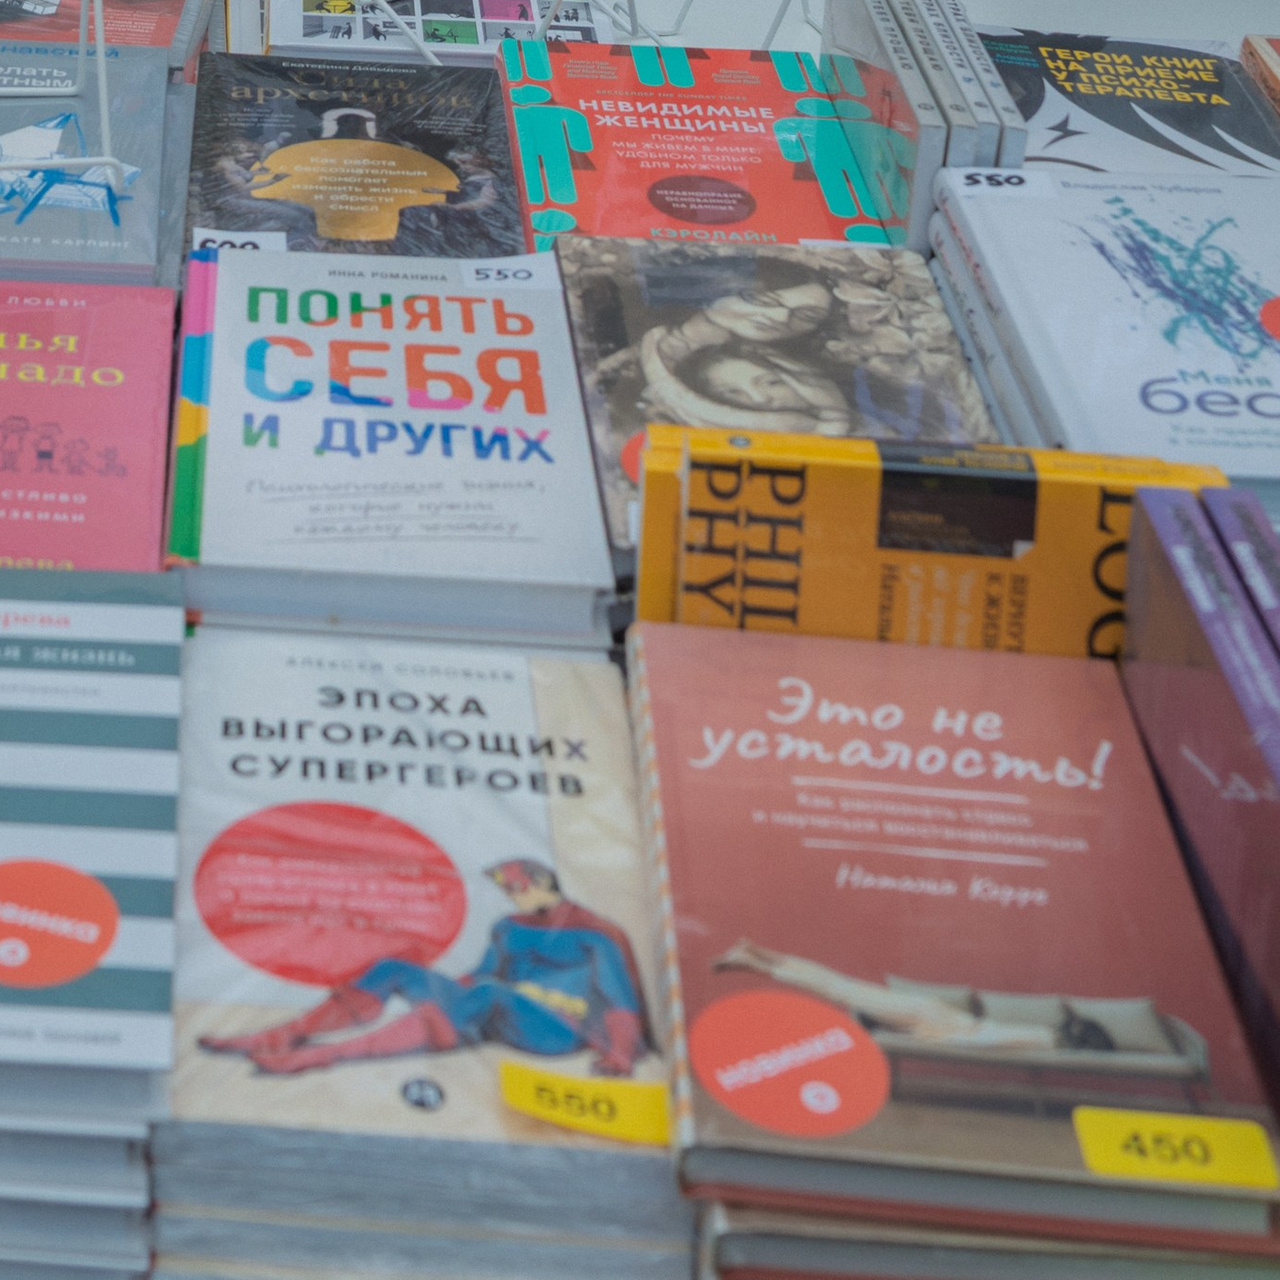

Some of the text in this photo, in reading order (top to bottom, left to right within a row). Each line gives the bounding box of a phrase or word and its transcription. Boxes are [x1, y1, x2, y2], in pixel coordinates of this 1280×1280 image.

[1038, 46, 1219, 70] ГЕРОИ КНИГ
[1045, 59, 1219, 82] НА ПРИЕМЕ
[1050, 70, 1192, 90] У ПСИХО-
[1056, 80, 1231, 106] ТЕРАПЕВТА
[578, 99, 775, 119] НЕВИДИМЫЕ
[593, 114, 766, 133] ЖЕНЩИНЫ
[651, 133, 715, 143] ПОЧЕМУ
[616, 150, 762, 164] УДОБНОМ ТОЛЬКО
[640, 160, 744, 172] ДЛЯ МУЖЧИН
[319, 175, 387, 186] помогает
[328, 268, 448, 282] ИННА РОМАНИНА
[474, 267, 534, 282] 550
[7, 295, 87, 308] ЛЮБВИ
[247, 286, 535, 337] ПОНЯТЬ
[244, 335, 548, 416] СЕБЯ
[242, 412, 556, 464] И ДРУГИХ
[317, 685, 489, 719] ЭПОХА
[767, 676, 1005, 741] Это не
[221, 716, 590, 761] ВЫГОРАЮЩИХ
[688, 725, 1114, 791] усталость!
[230, 752, 585, 798] СУПЕРГЕРОЕВ
[534, 1084, 618, 1124] 550
[1121, 1129, 1213, 1167] 450
